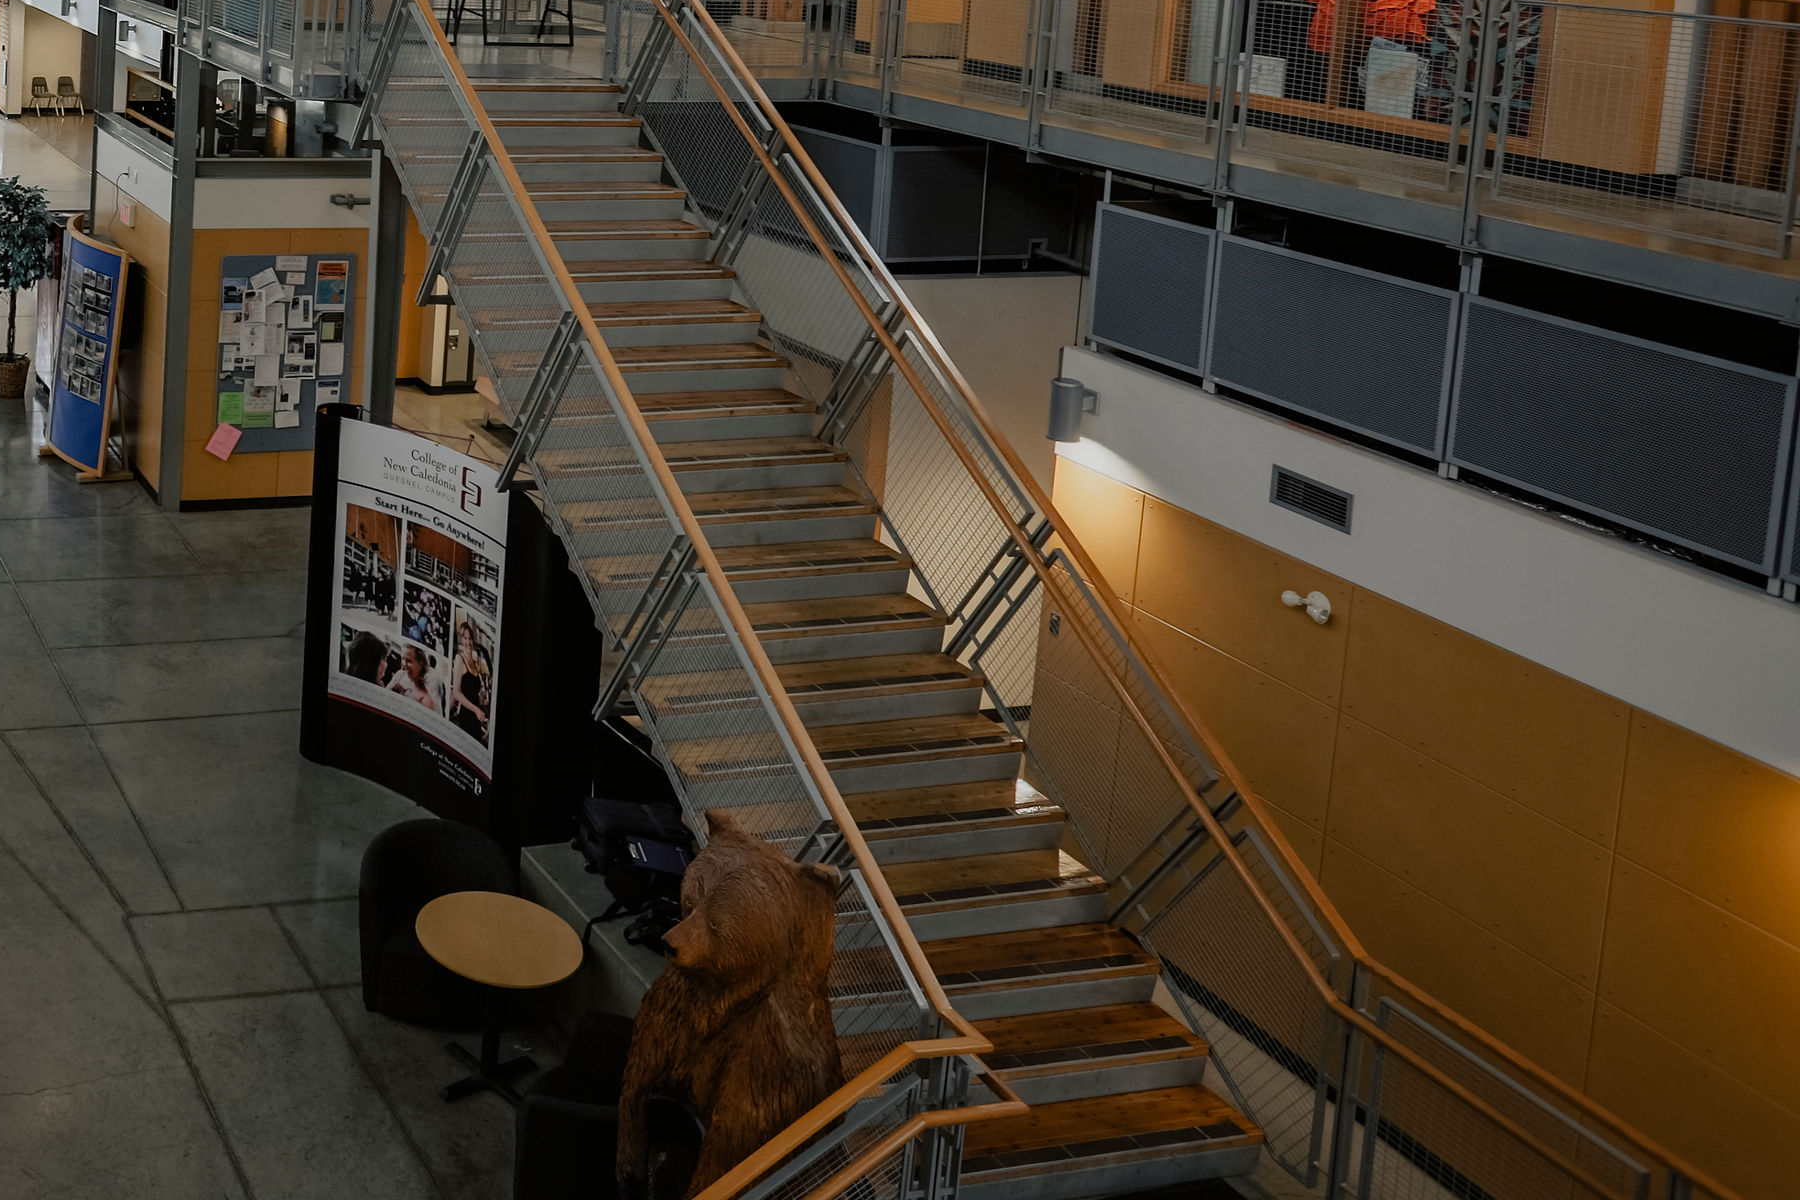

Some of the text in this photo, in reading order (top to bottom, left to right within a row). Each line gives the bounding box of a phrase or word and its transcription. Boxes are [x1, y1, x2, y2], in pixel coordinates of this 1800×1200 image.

[384, 456, 456, 492] New Caledonia
[411, 449, 458, 475] College of
[383, 473, 455, 504] QUESNEL CAMPUS
[375, 496, 397, 511] Start
[433, 516, 445, 528] Go
[446, 523, 485, 550] Anywhere!
